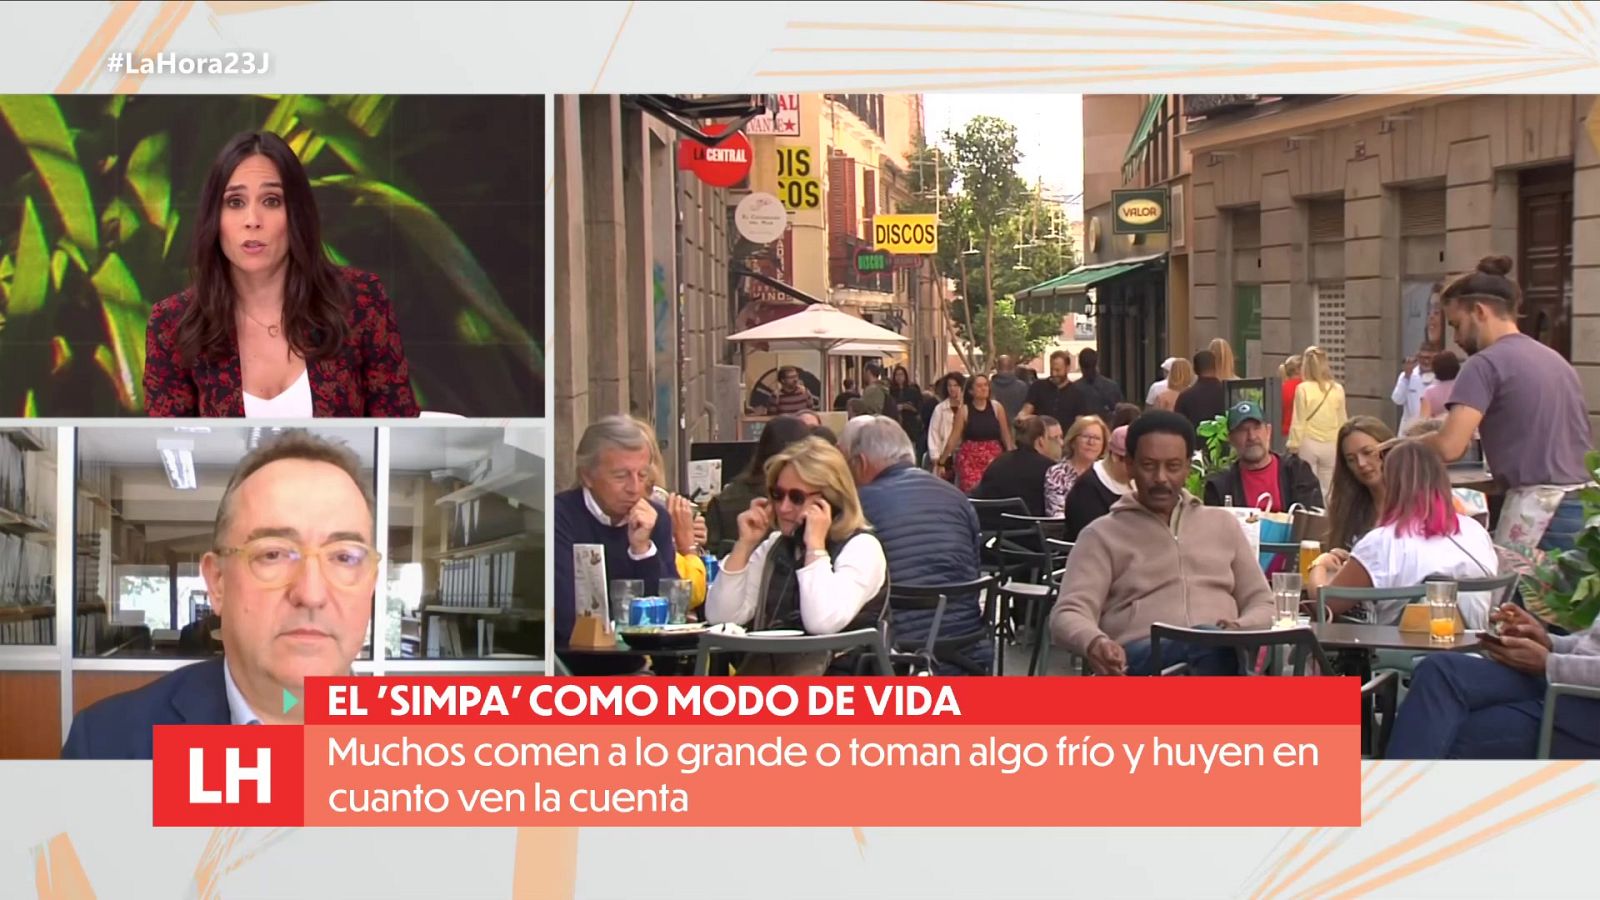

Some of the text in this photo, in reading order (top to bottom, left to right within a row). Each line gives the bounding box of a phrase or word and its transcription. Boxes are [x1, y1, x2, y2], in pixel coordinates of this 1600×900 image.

[706, 148, 748, 163] CENTRAL
[1122, 207, 1157, 217] VALOR
[876, 224, 935, 244] DISCOS
